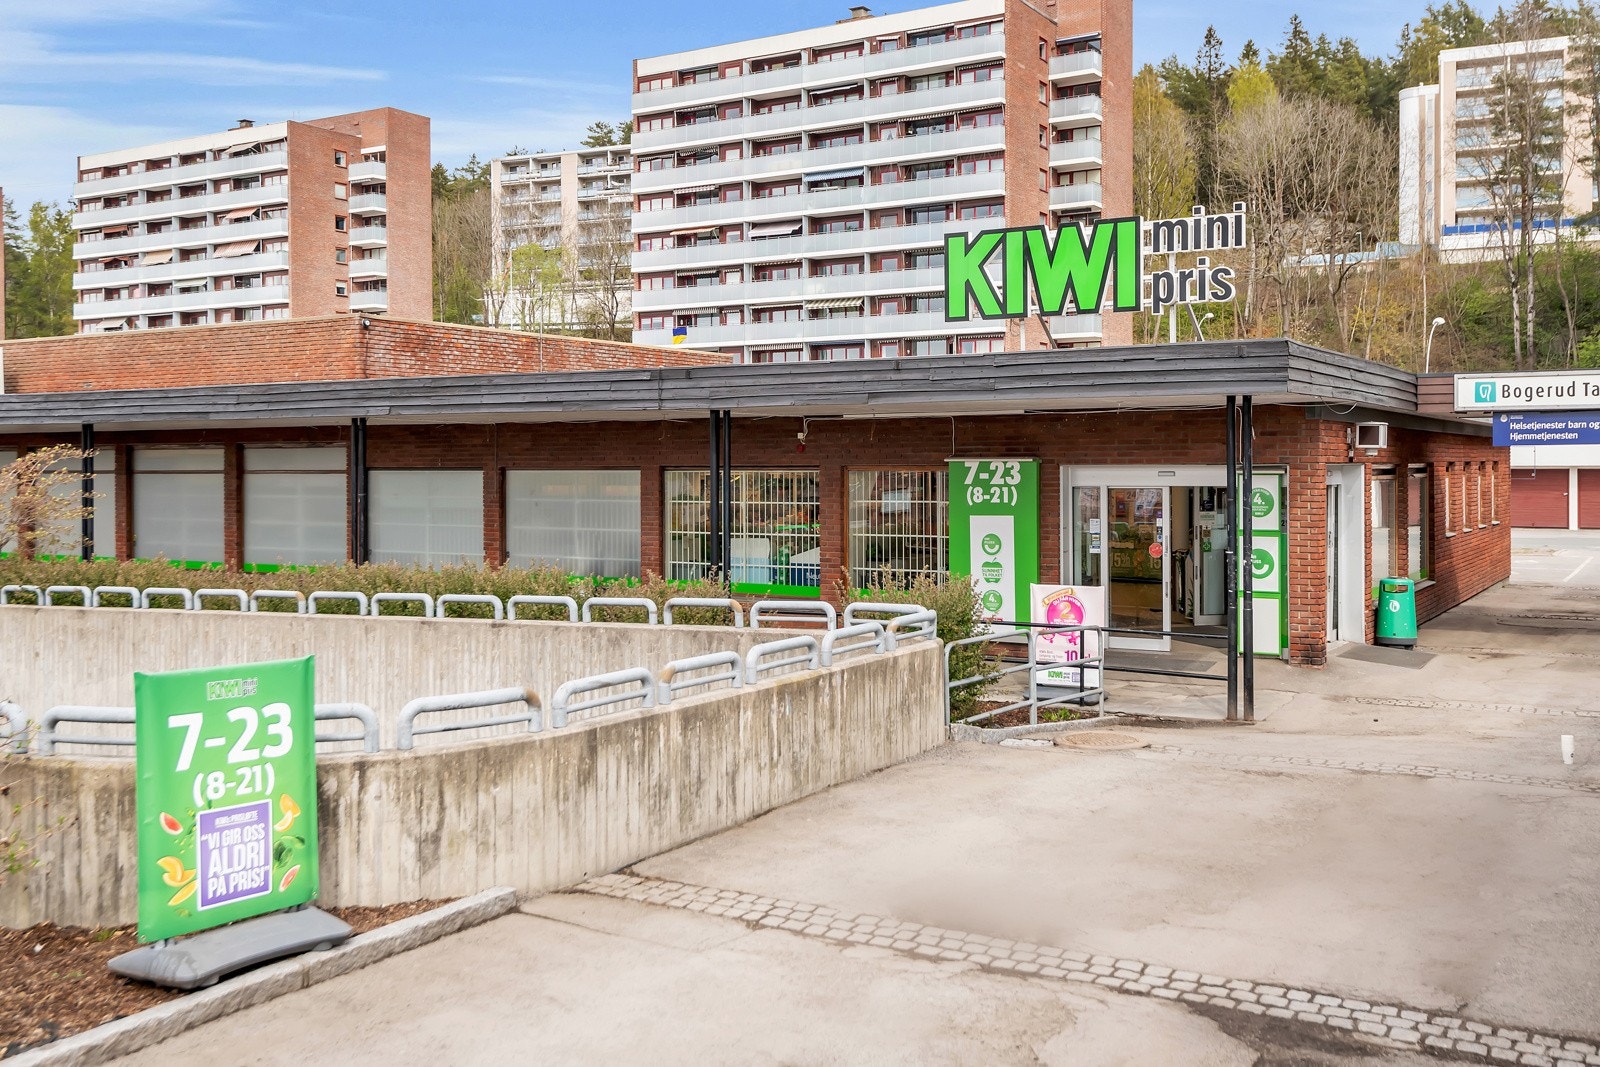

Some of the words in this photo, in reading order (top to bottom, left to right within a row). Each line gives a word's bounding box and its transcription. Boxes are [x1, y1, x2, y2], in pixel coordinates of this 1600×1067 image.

[943, 215, 1143, 323] KIWI
[1151, 201, 1247, 255] mini
[1151, 256, 1237, 316] pris
[1501, 380, 1576, 402] Bogerud
[1510, 421, 1566, 431] Helsetjenester
[1568, 420, 1587, 429] barn
[1588, 422, 1600, 431] og
[1510, 431, 1578, 441] Hjemmetjenesten
[964, 461, 1021, 485] 7-23
[966, 486, 1018, 507] (8-21)
[207, 679, 242, 700] KIWI
[167, 702, 294, 772] 7-23
[192, 762, 275, 808] (8-21)
[221, 827, 242, 848] GIR
[242, 823, 266, 843] OSS
[207, 839, 265, 880] ALDRI
